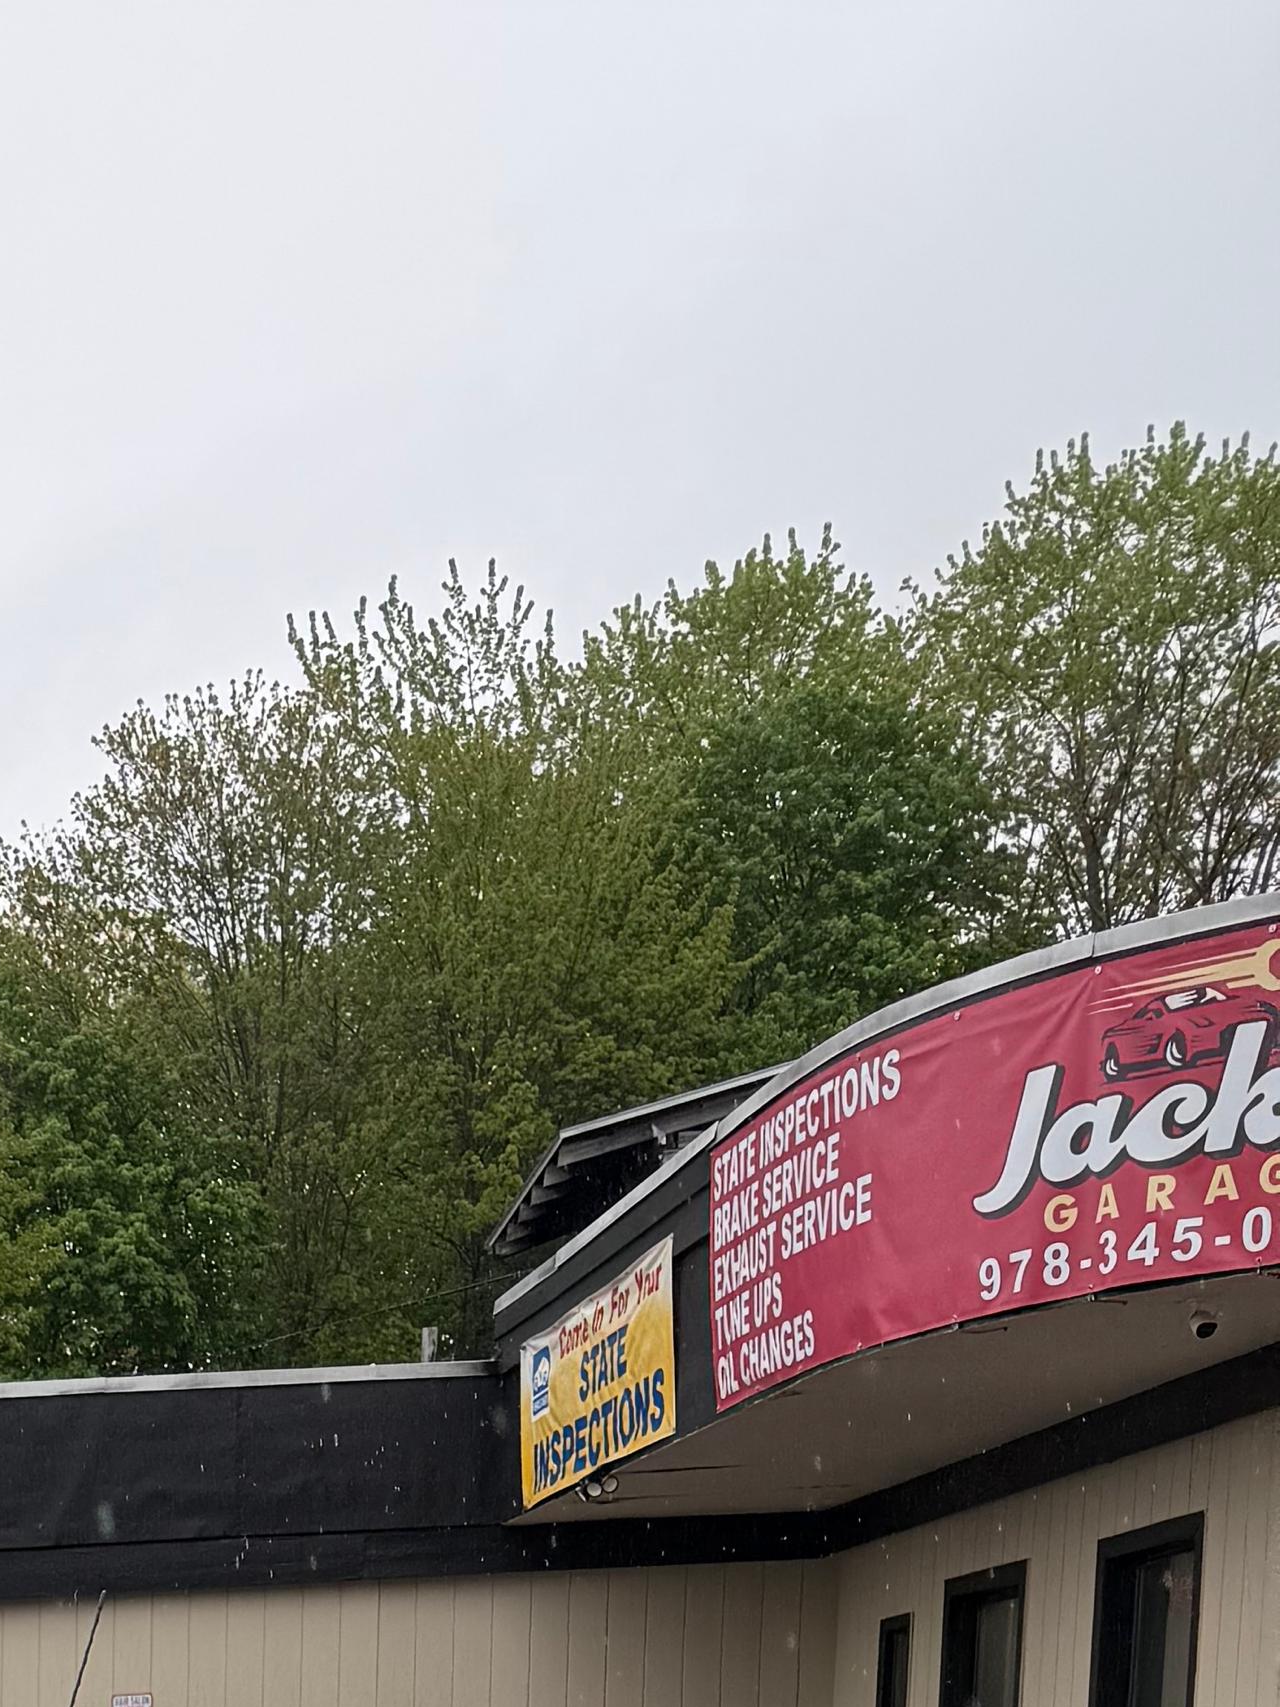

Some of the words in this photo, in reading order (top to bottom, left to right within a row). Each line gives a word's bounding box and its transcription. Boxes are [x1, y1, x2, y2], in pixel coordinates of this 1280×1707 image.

[714, 1130, 757, 1202] STATE
[759, 1049, 901, 1170] INSPECTIONS
[714, 1180, 759, 1252] BRAKE
[762, 1131, 840, 1219] SERVICE
[714, 1222, 777, 1302] EXHAUST
[781, 1173, 873, 1260] SERVICE
[558, 1317, 590, 1360] Come
[608, 1285, 630, 1325] For
[634, 1262, 663, 1305] Your
[578, 1323, 629, 1403] STATE
[715, 1289, 751, 1351] TUNE
[753, 1271, 782, 1328] UPS
[717, 1350, 739, 1400] OIL
[739, 1309, 814, 1387] CHANGES
[532, 1367, 665, 1496] INSPECTIONS
